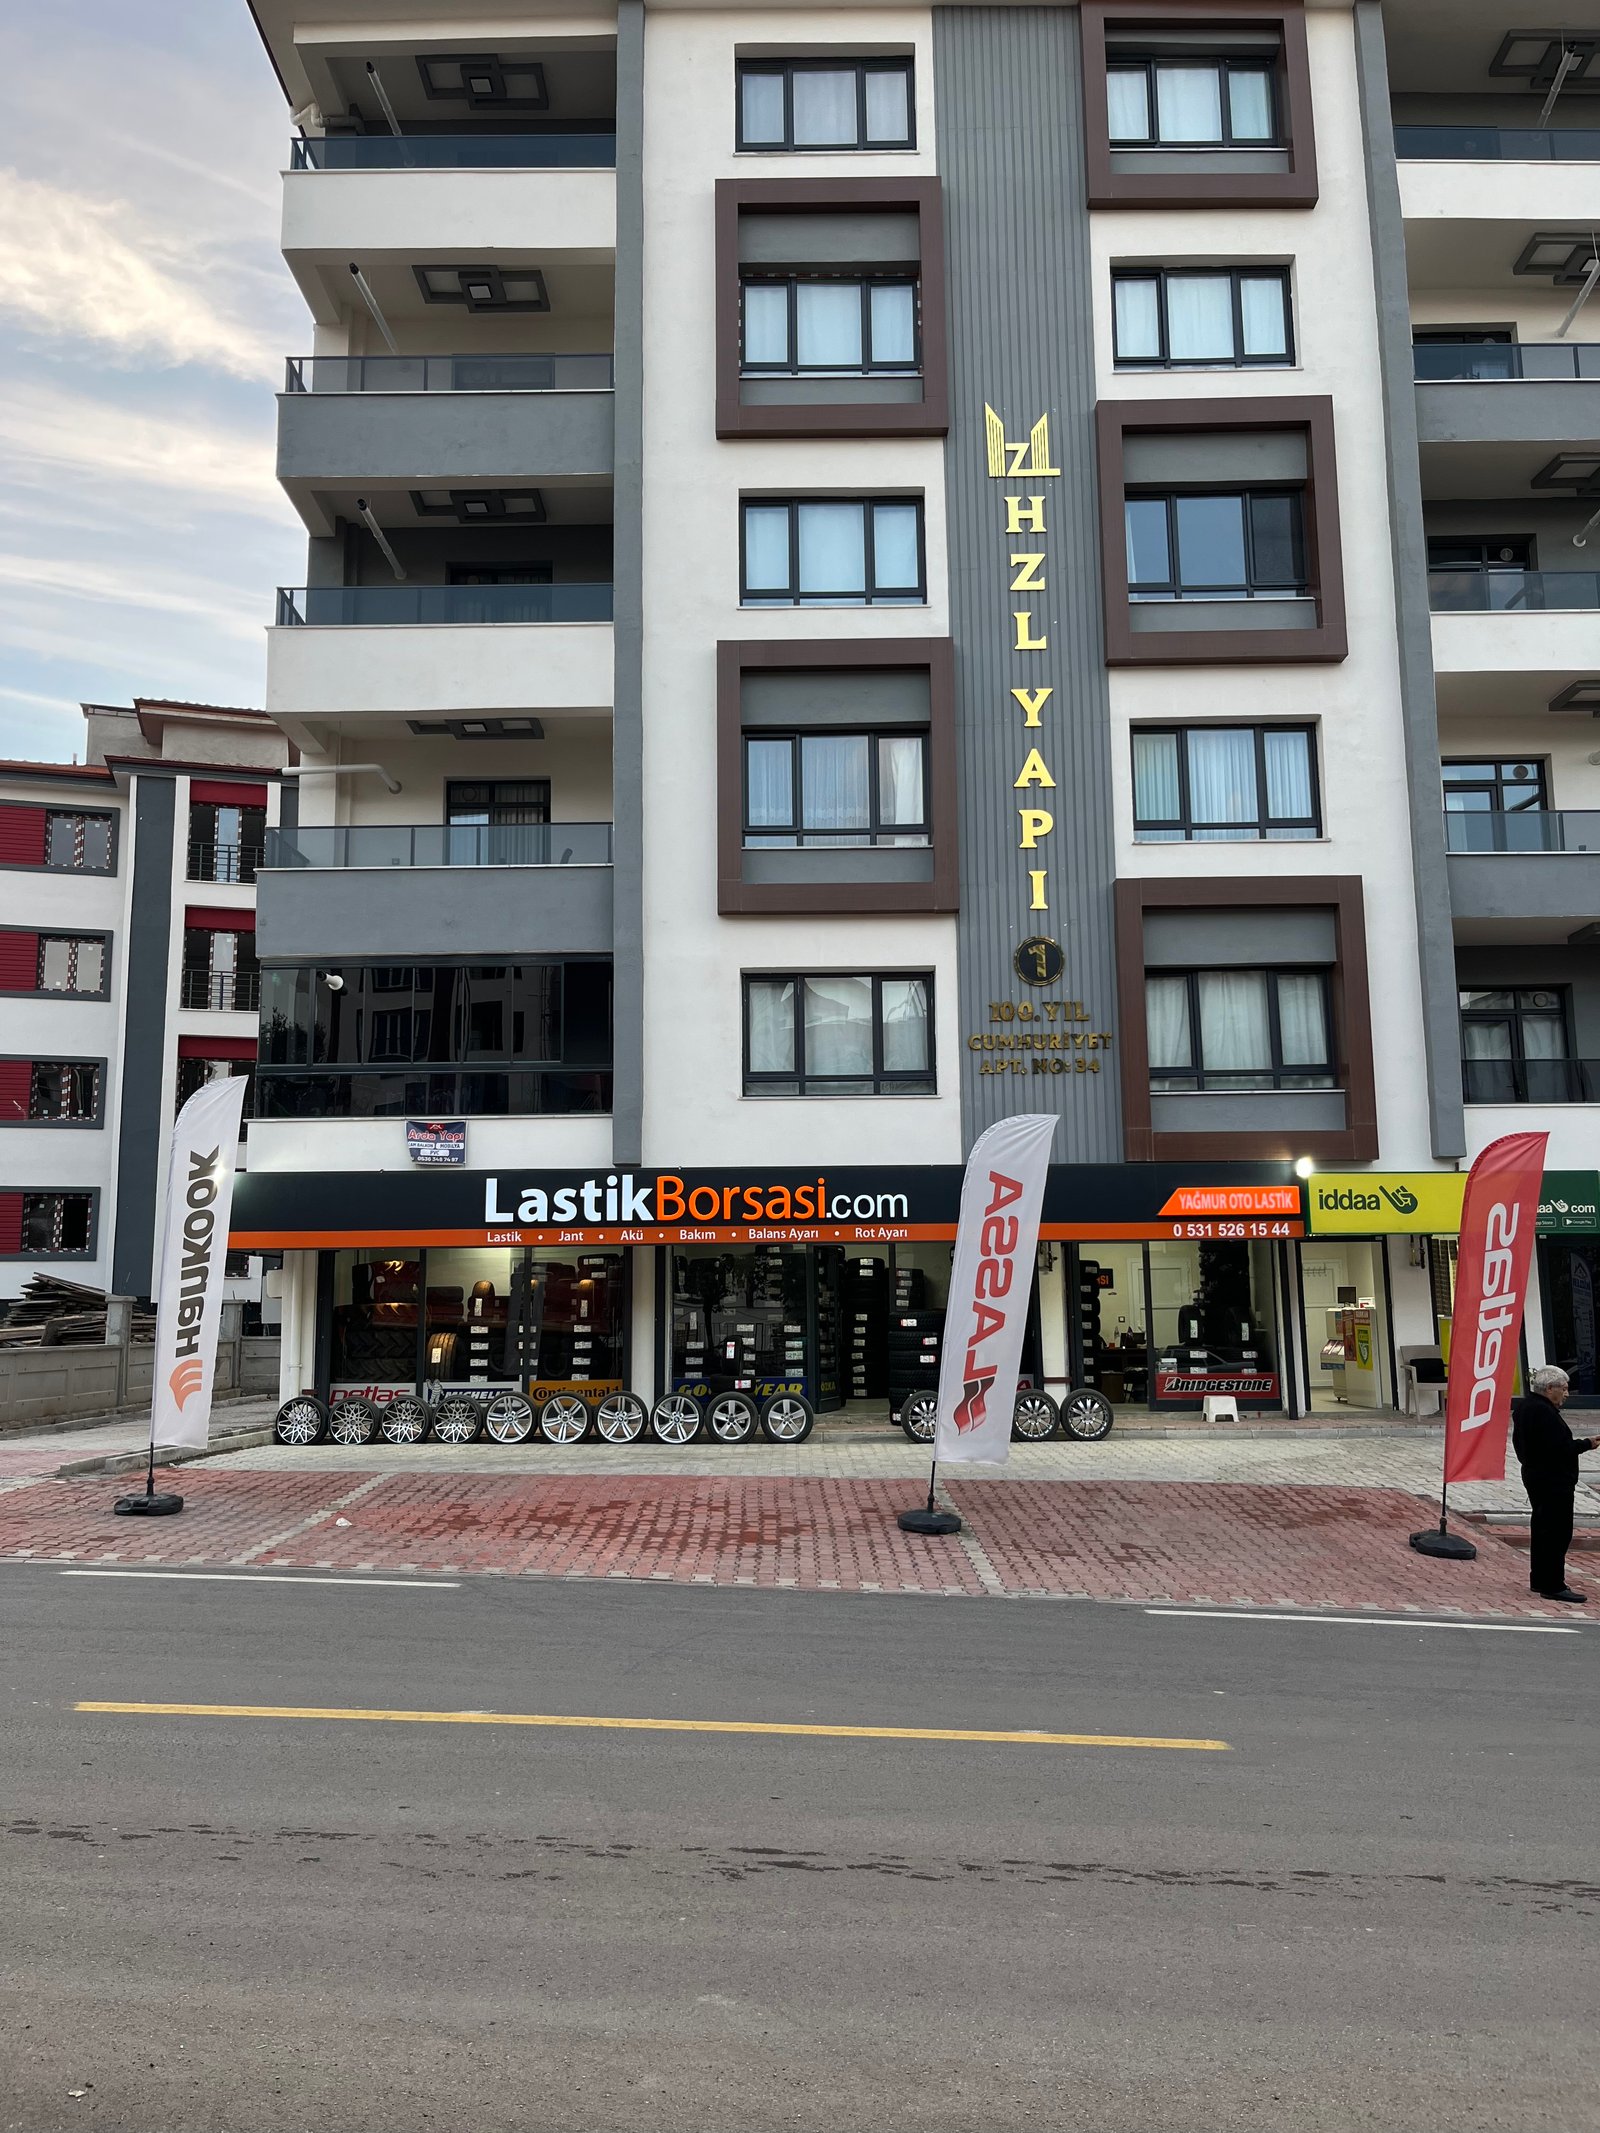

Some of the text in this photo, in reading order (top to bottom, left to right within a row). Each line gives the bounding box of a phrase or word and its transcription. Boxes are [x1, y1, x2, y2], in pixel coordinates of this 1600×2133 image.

[1027, 944, 1047, 978] 1
[1074, 1057, 1100, 1073] 34
[408, 1129, 436, 1140] Arda
[485, 1174, 909, 1223] LastikBorsasi.com
[1179, 1190, 1293, 1210] YAĞMUR OTO LASTİK
[1318, 1188, 1380, 1211] iddaa
[487, 1227, 908, 1243] Lastik Jant Akü Bakım Balans Ayarı Rot Ayarı
[1173, 1222, 1290, 1237] 0 531 526 15 44
[1164, 1377, 1273, 1392] BRIDGESTONE
